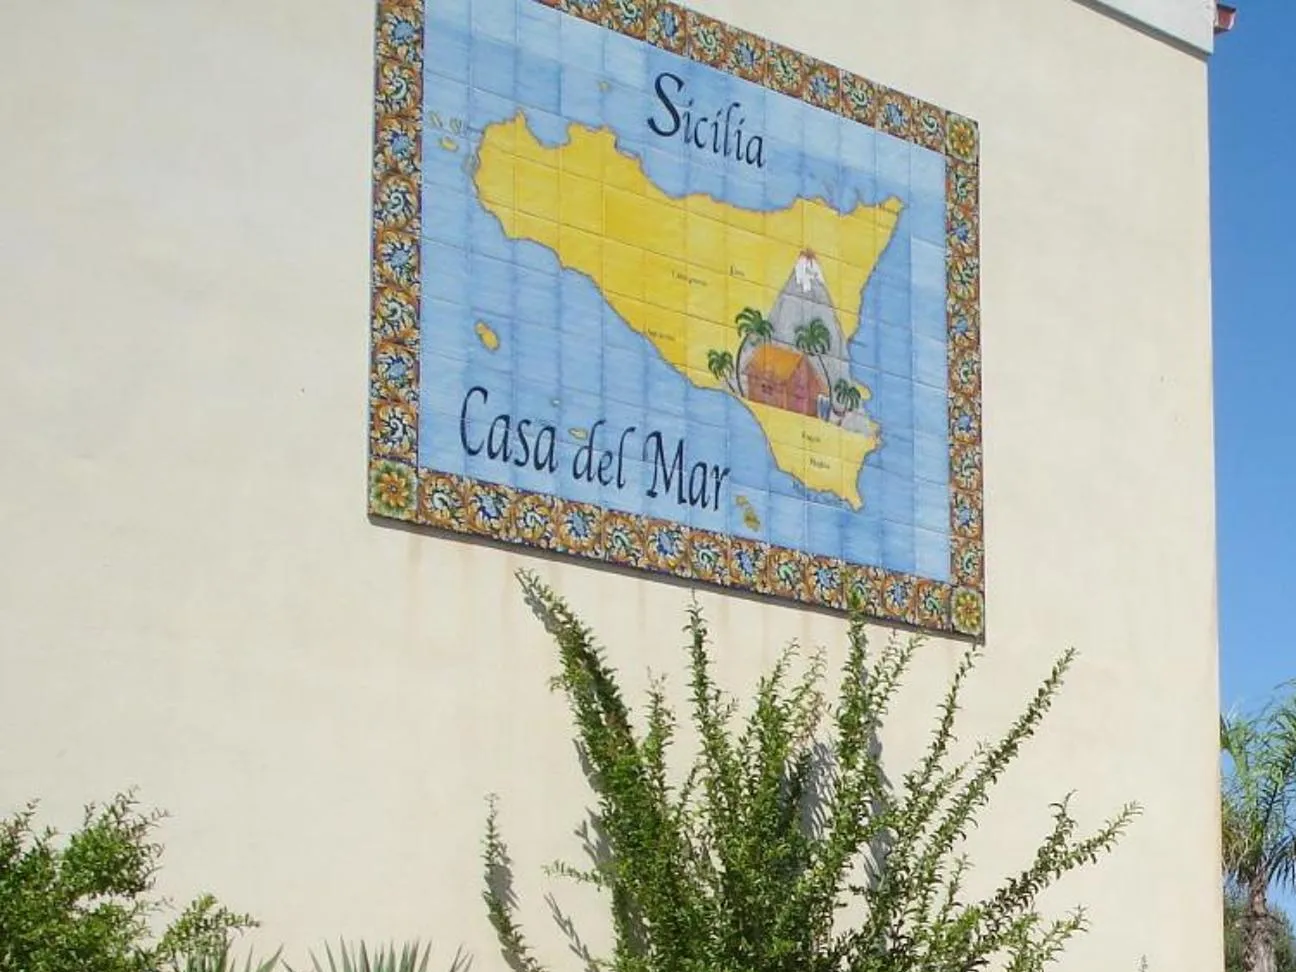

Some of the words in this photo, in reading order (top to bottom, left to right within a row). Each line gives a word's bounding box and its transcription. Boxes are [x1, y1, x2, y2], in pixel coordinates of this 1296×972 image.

[647, 72, 765, 168] Sicilia
[459, 385, 558, 473] Casa
[572, 419, 636, 489] del
[642, 430, 730, 512] Mar
